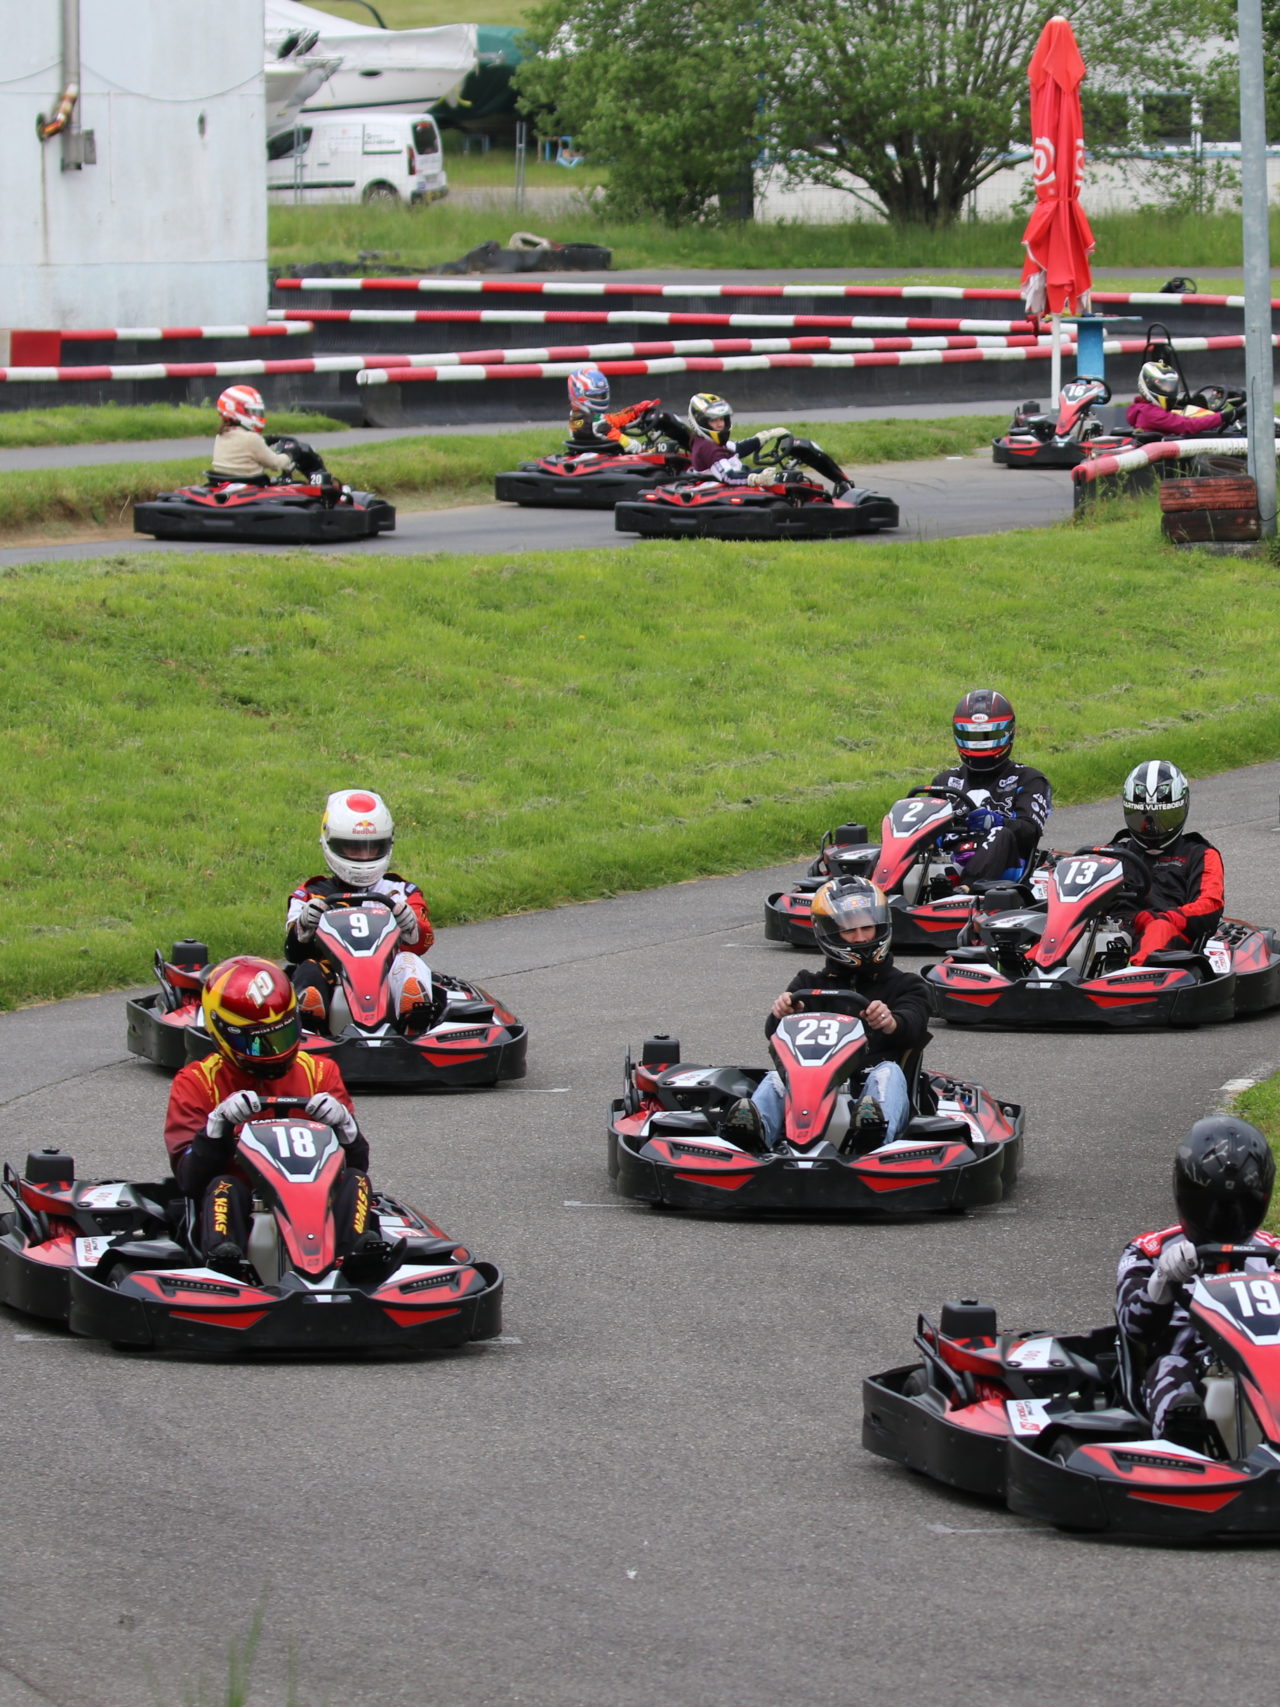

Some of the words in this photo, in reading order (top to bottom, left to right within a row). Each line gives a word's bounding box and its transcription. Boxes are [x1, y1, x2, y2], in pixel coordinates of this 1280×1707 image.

[1068, 384, 1087, 397] 16
[657, 442, 668, 452] 10
[310, 473, 322, 486] 20
[782, 472, 788, 482] 7
[902, 801, 924, 822] 2
[1063, 861, 1098, 884] 13
[349, 913, 370, 938] 9
[795, 1018, 840, 1046] 23
[272, 1126, 317, 1158] 18
